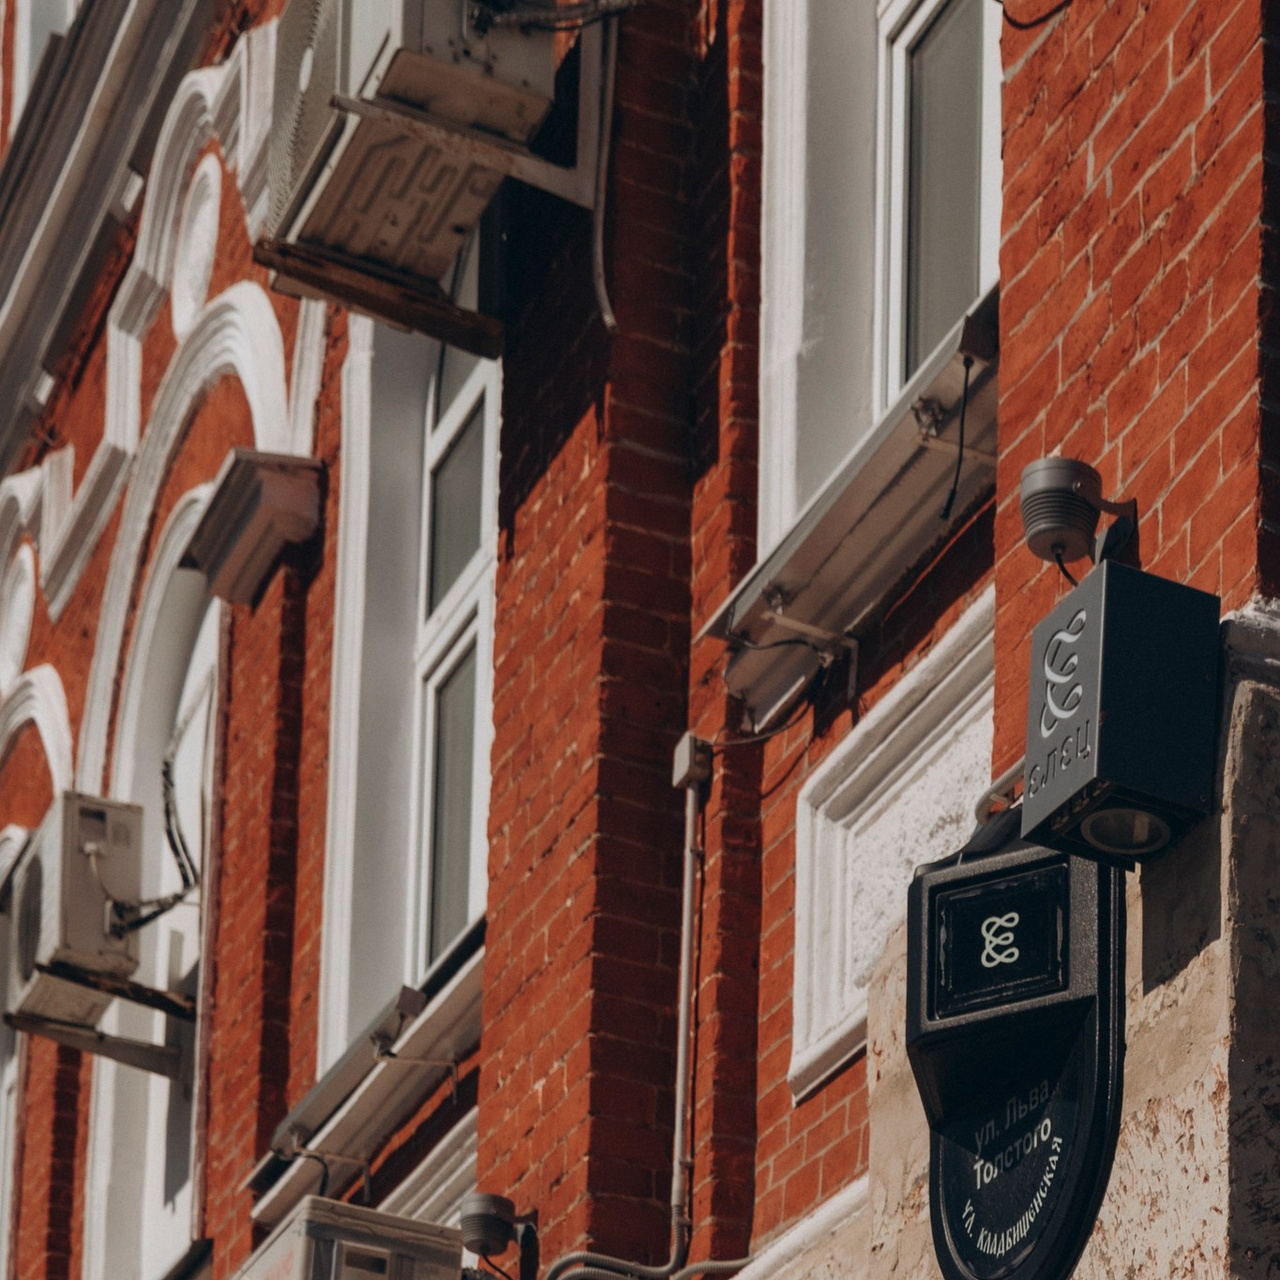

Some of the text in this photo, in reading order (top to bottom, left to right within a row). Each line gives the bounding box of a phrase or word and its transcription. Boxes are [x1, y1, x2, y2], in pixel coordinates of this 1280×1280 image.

[973, 1117, 1052, 1190] Толстого
[974, 1079, 1049, 1160] ул. Льва
[976, 1136, 1063, 1259] КЛАДБИЩЕНСКАЯ
